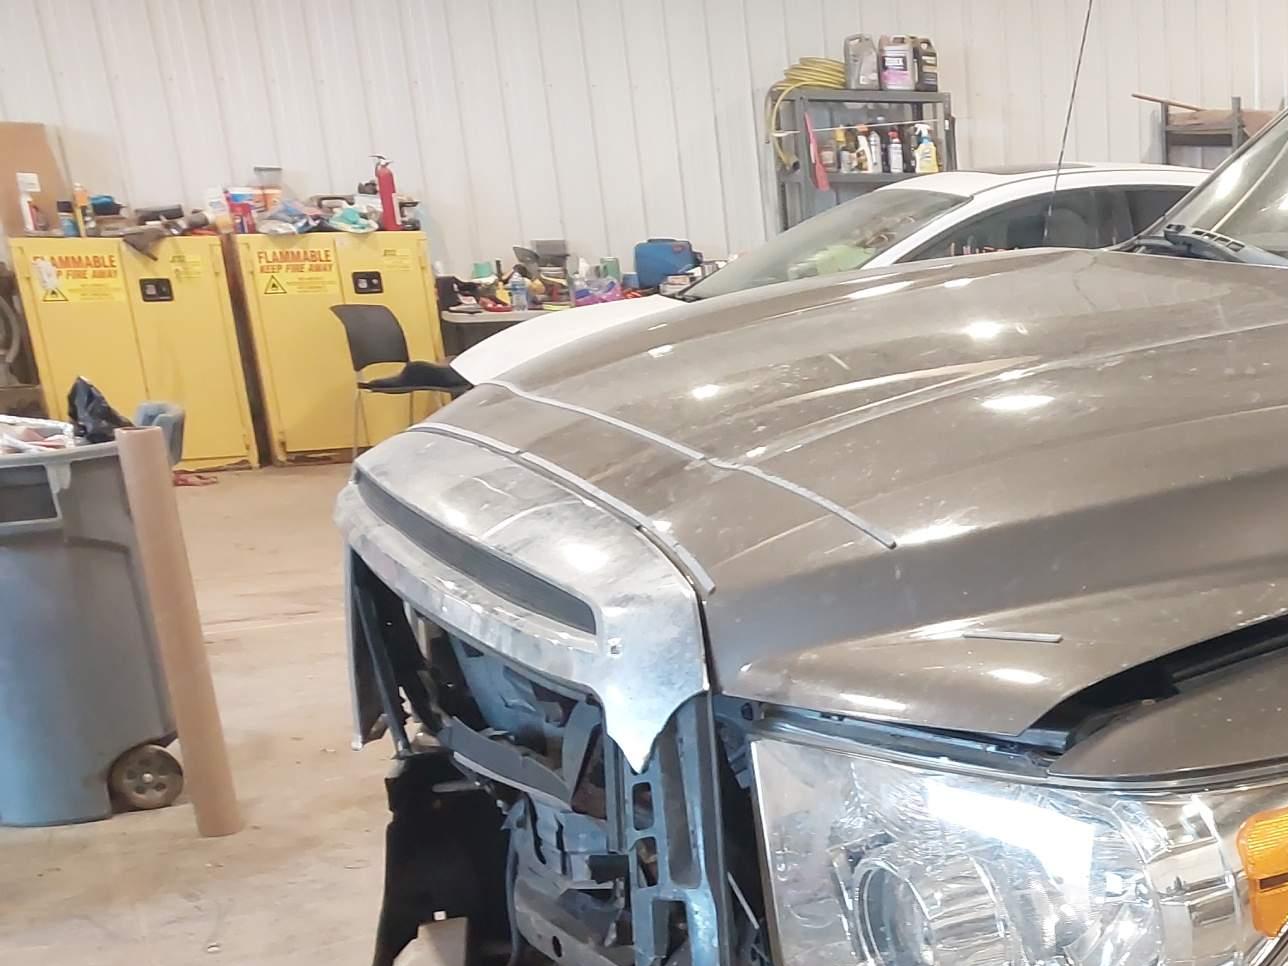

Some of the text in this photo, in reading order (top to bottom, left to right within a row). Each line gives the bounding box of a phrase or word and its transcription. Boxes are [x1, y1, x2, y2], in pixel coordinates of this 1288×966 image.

[32, 254, 118, 269] AMMABLE
[257, 249, 332, 264] FLAMMABLE
[260, 264, 282, 274] KEEP
[285, 263, 305, 273] FIRE
